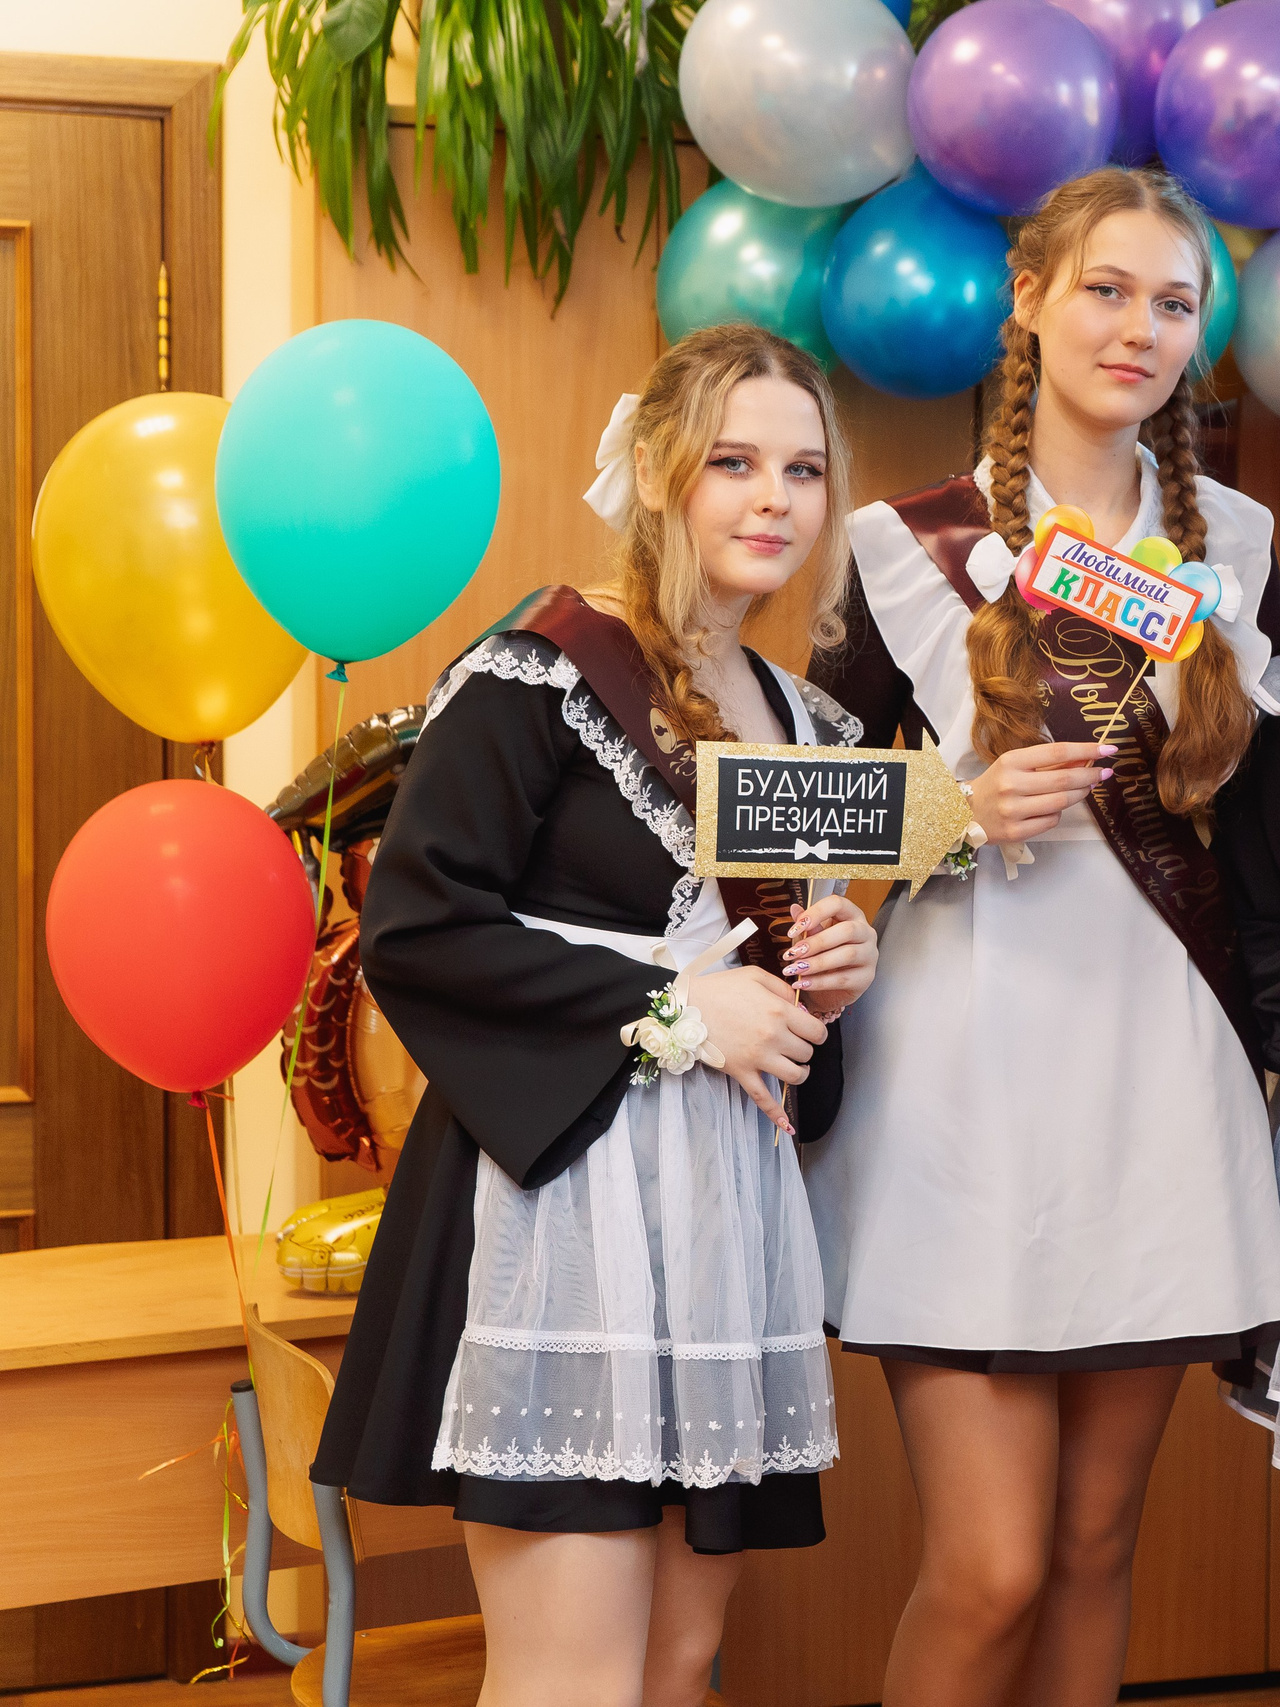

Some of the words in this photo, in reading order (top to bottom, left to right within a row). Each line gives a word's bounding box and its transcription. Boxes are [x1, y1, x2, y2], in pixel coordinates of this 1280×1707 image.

[1061, 542, 1172, 604] Любимый
[1049, 567, 1182, 646] КЛАСС!
[737, 768, 888, 804] БУДУЩИЙ
[735, 805, 888, 837] ПРЕЗИДЕНТ
